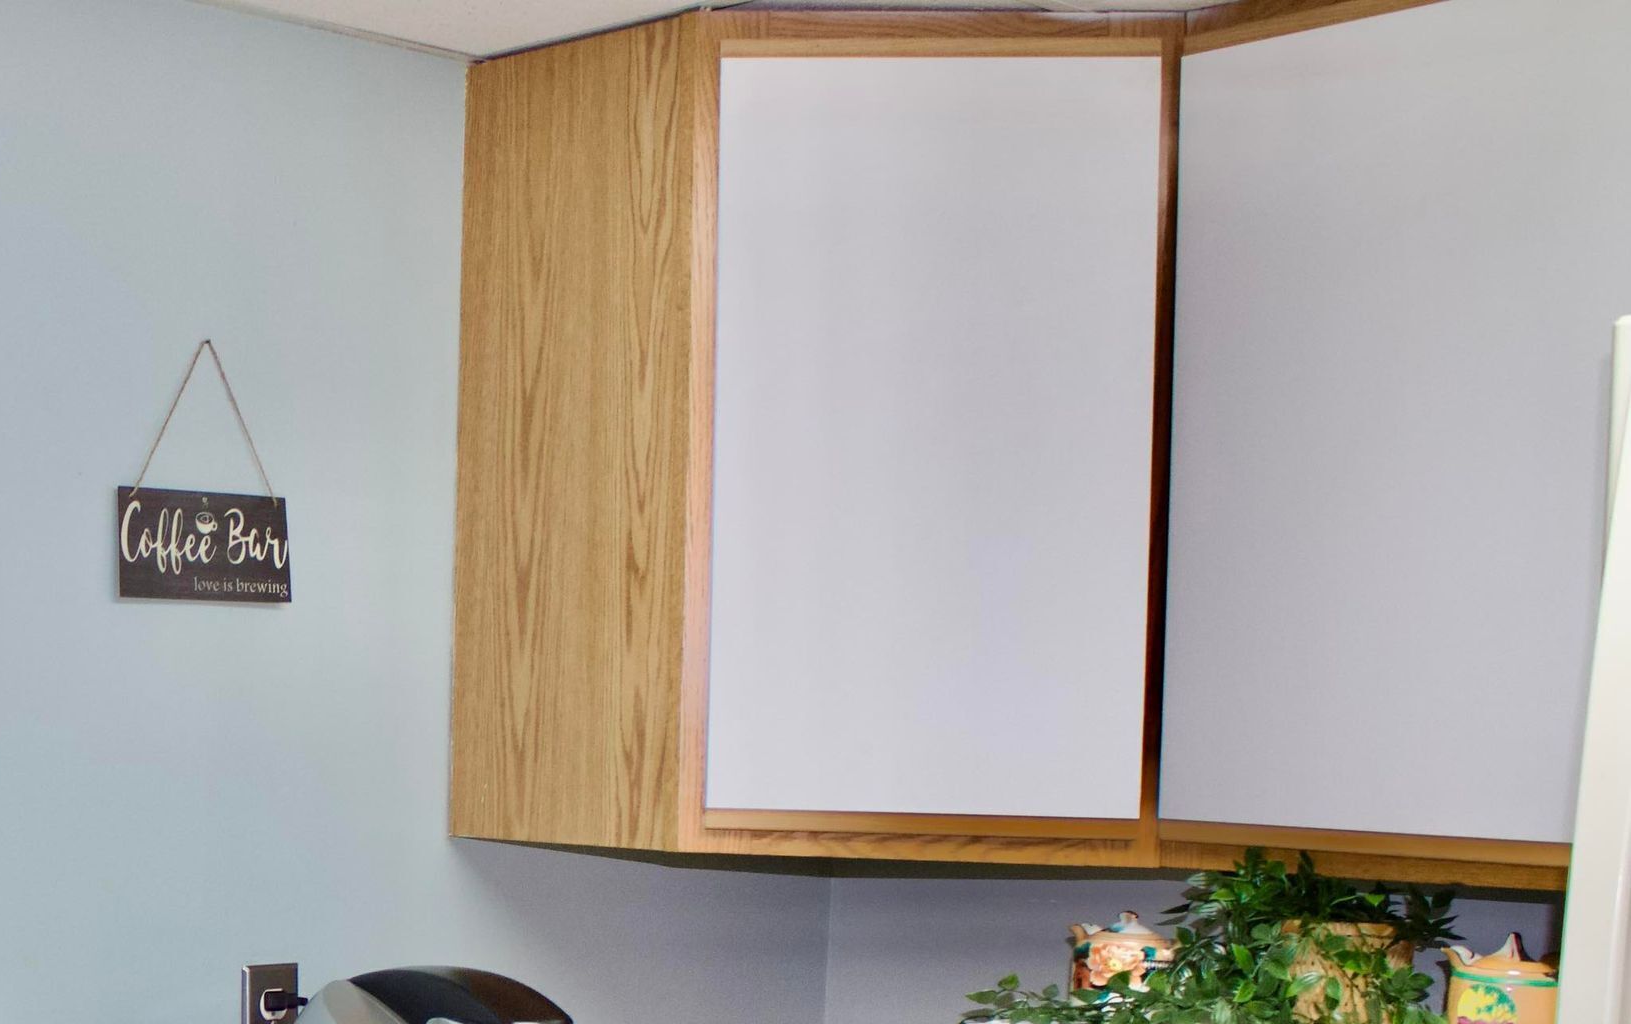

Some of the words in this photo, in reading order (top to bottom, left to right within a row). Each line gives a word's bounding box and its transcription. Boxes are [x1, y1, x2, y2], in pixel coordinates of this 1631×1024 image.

[121, 500, 217, 575] Coffee
[224, 508, 287, 569] Bar
[194, 576, 220, 592] love
[223, 577, 233, 592] is
[236, 579, 288, 598] brewing
